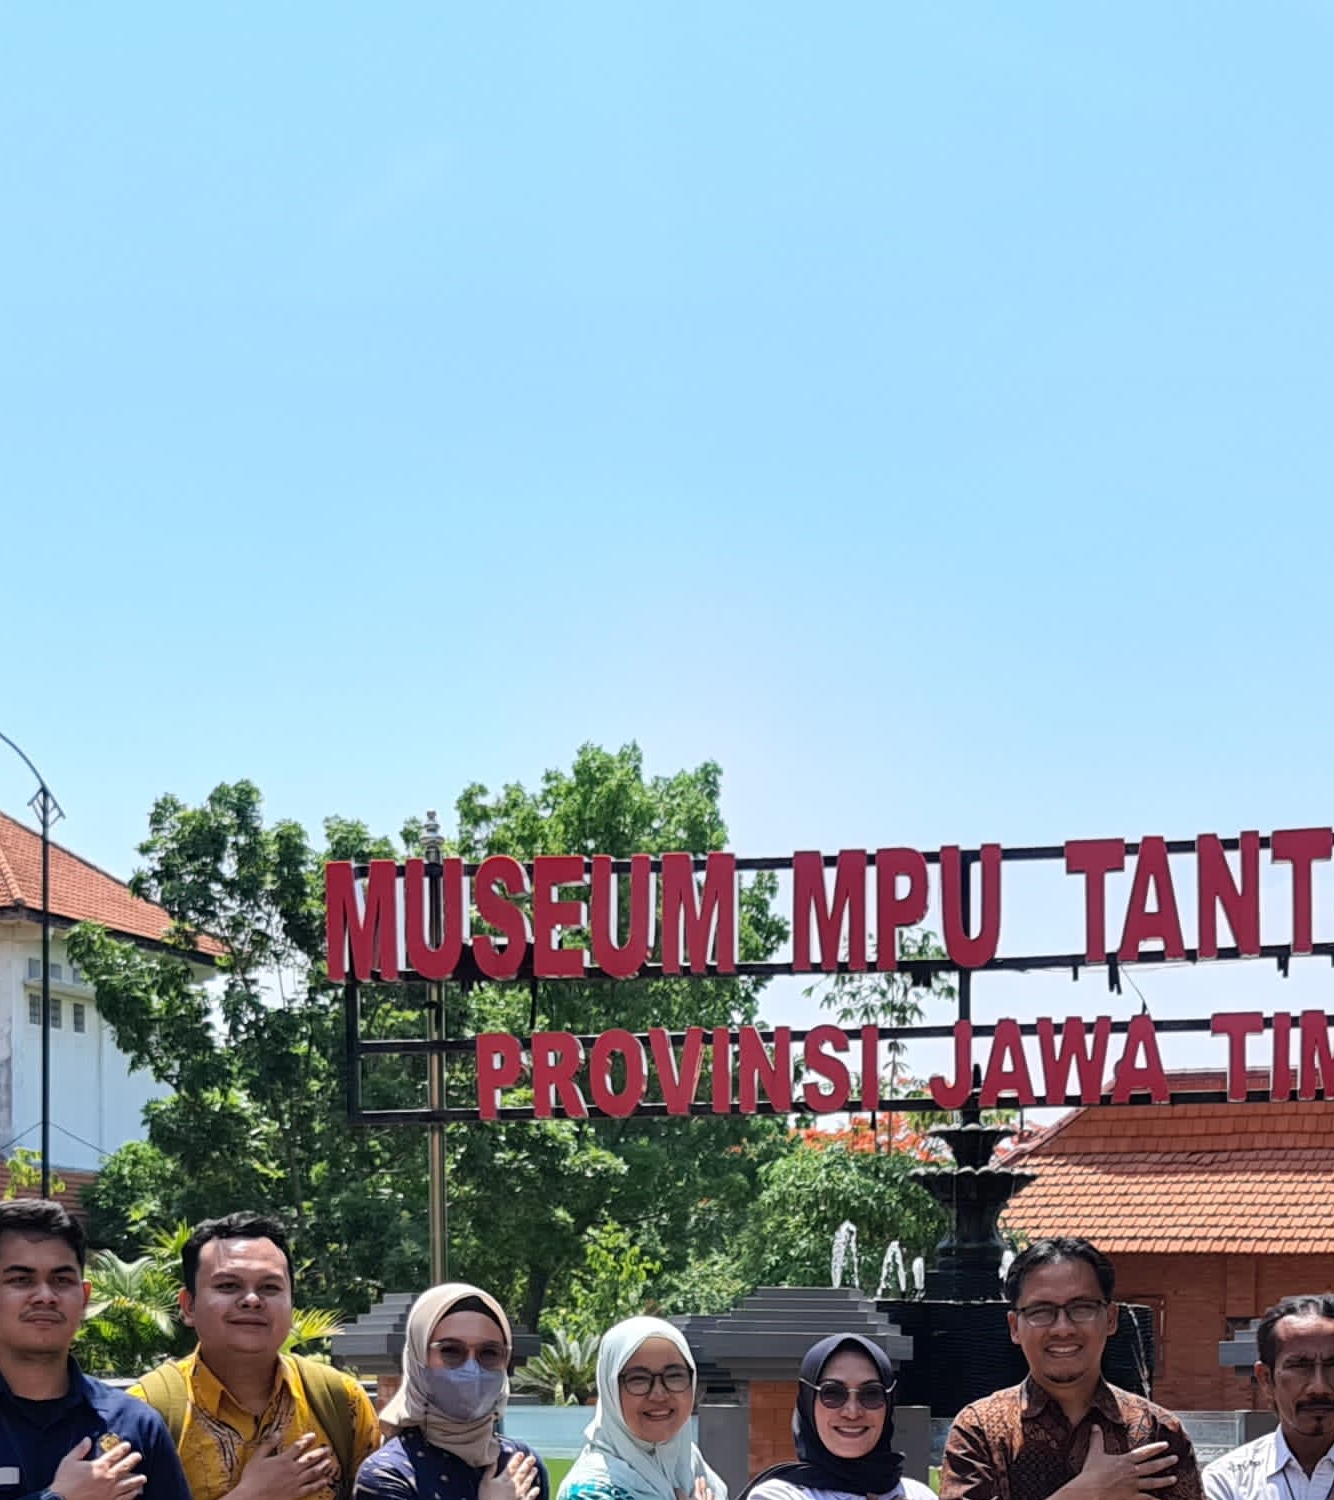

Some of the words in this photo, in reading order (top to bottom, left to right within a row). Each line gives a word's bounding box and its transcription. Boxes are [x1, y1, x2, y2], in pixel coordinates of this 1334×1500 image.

[325, 852, 739, 983] MUSEUM
[793, 844, 1002, 972] MPU
[475, 1023, 880, 1121] PROVINSI
[929, 1014, 1170, 1110] JAWA
